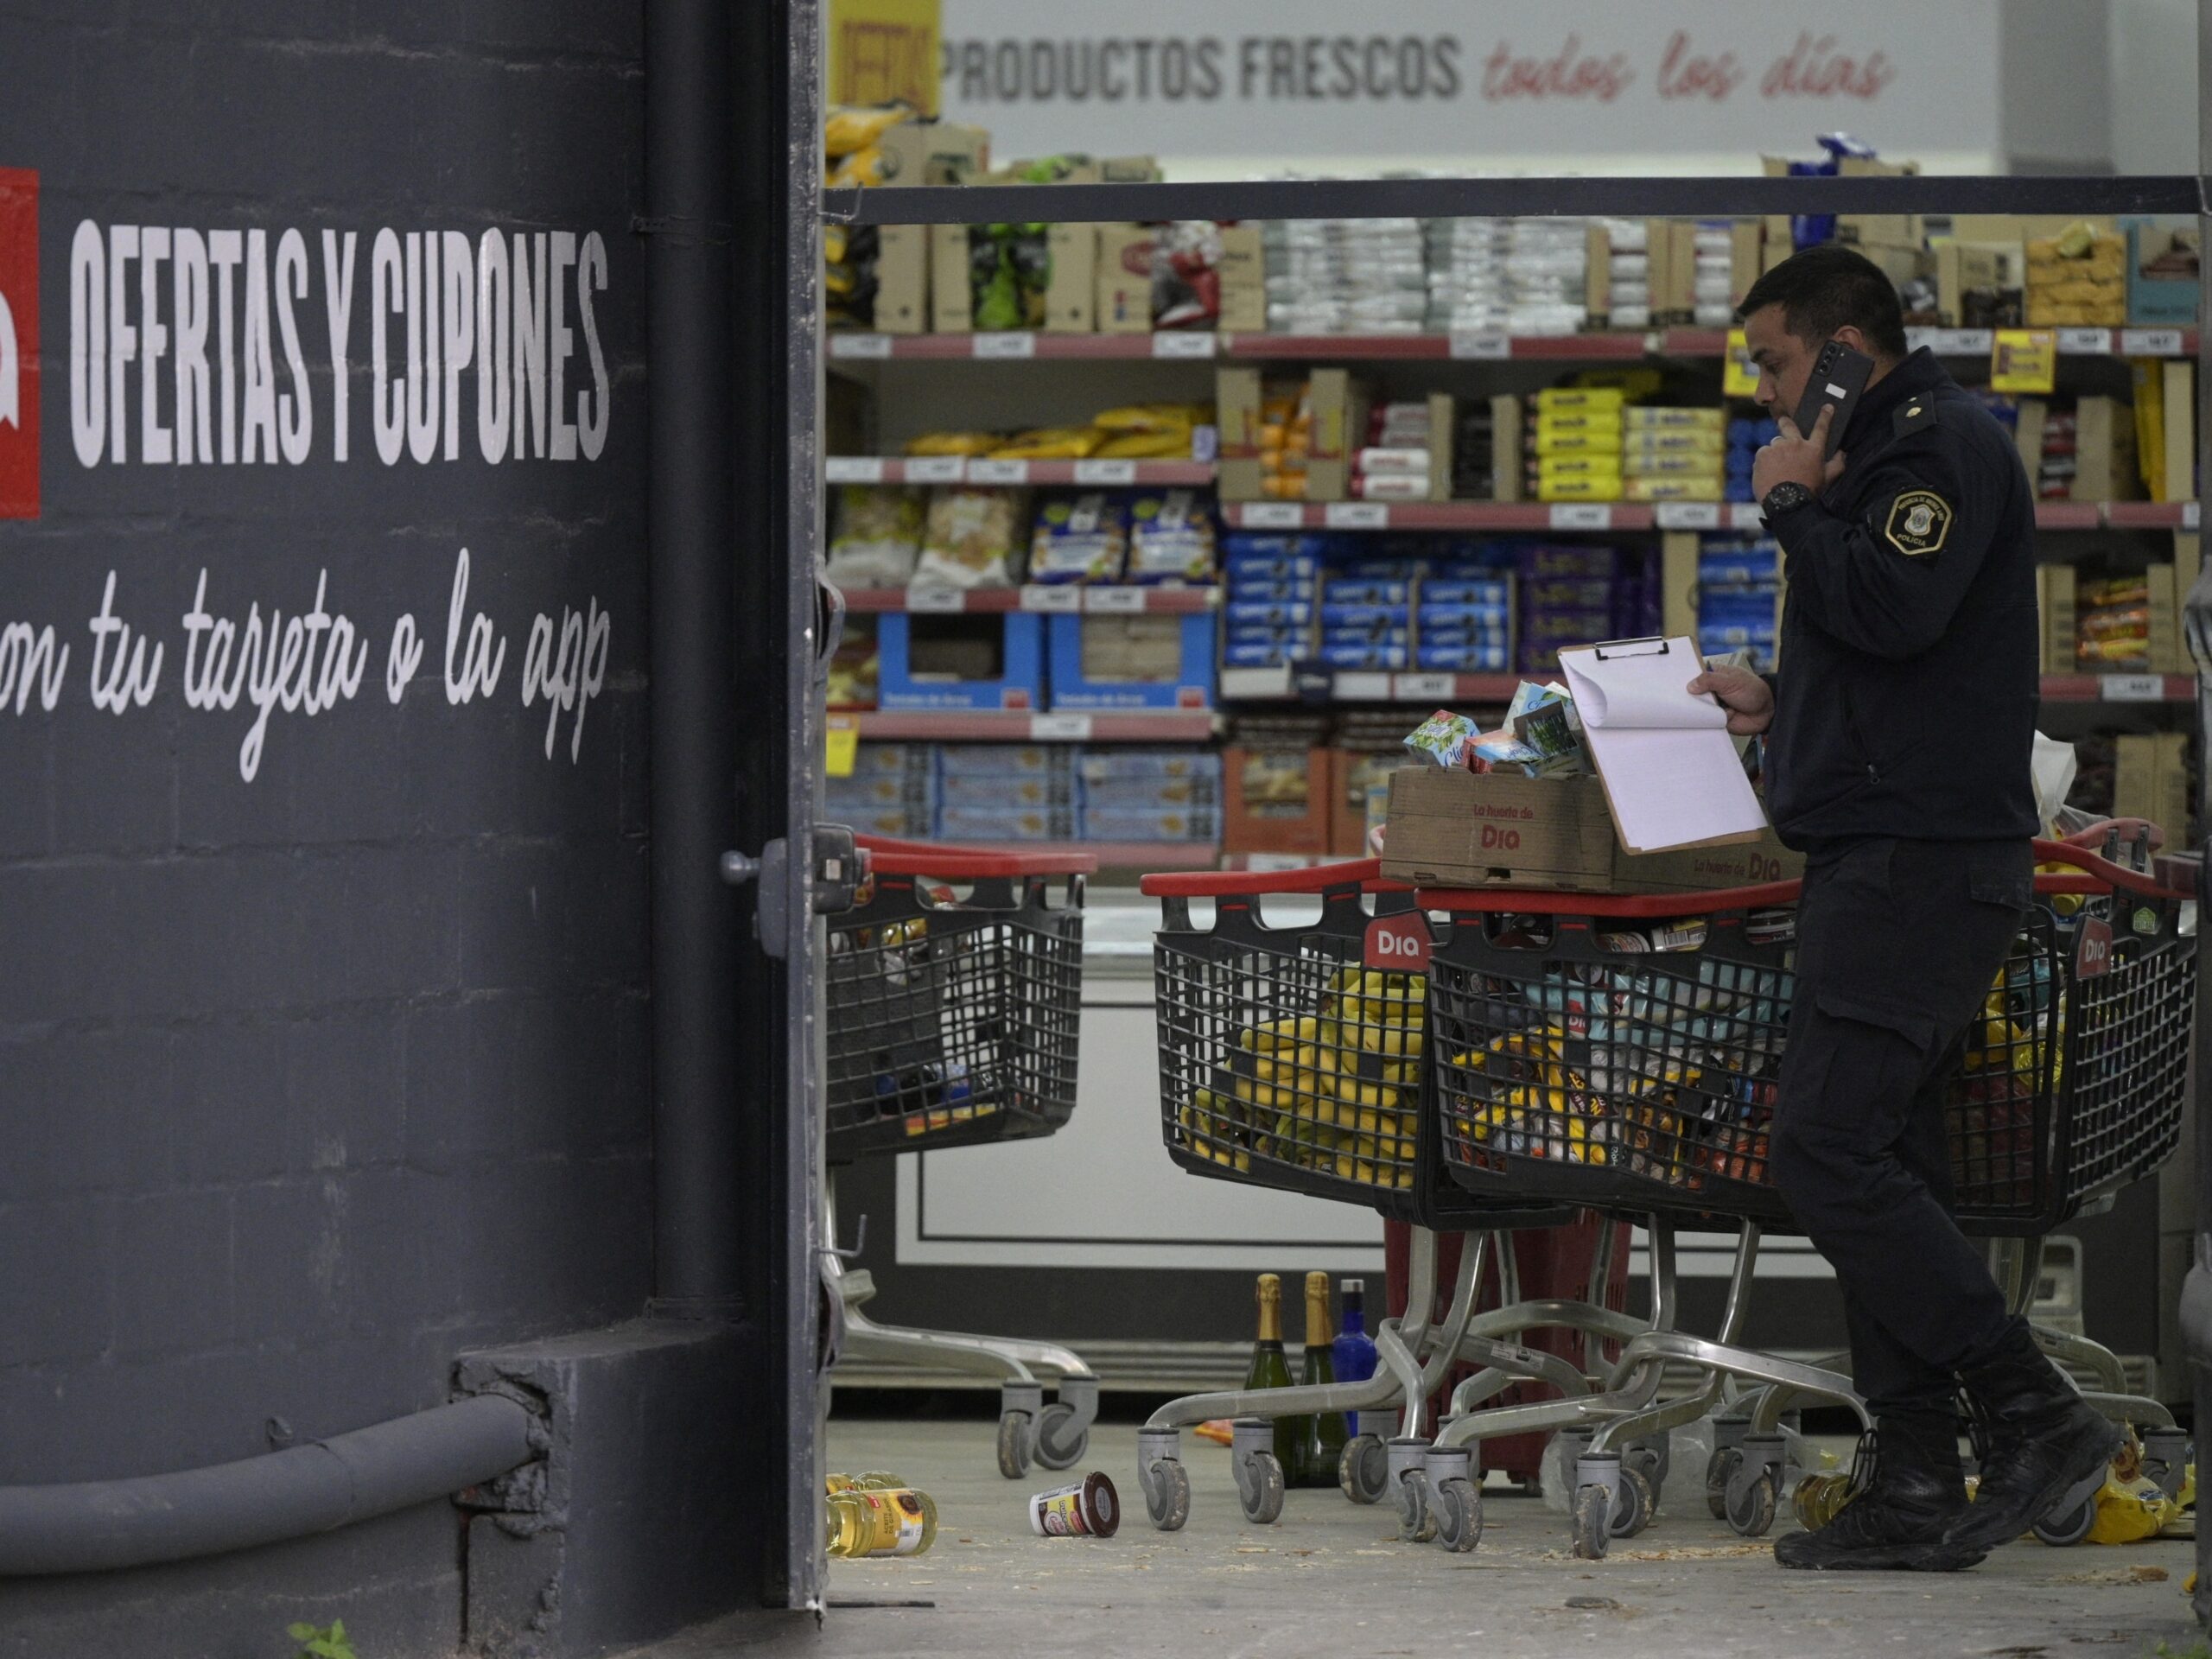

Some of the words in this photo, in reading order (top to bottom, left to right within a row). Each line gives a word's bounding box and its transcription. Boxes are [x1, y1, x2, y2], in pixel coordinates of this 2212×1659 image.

[1242, 35, 1461, 101] FRESCOS
[1483, 33, 1633, 101] todos
[1656, 30, 1743, 99] los
[1759, 30, 1894, 99] días
[70, 219, 313, 469] OFERTAS
[322, 228, 357, 463] Y
[372, 226, 610, 466] CUPONES
[1897, 534, 1926, 547] POLICIA
[90, 569, 163, 715] tu
[183, 566, 368, 781] tarjeta
[386, 611, 423, 704] o
[445, 546, 506, 705] la
[522, 594, 610, 765] app
[1474, 804, 1485, 817] La
[1486, 804, 1519, 819] huerta
[1521, 807, 1534, 819] de
[1481, 824, 1521, 850] Dia
[1694, 859, 1705, 872] La
[1706, 860, 1732, 875] huerta
[1732, 864, 1745, 876] de
[1748, 853, 1782, 880] Dia
[1378, 931, 1420, 957] Dia
[2086, 939, 2105, 963] Dia
